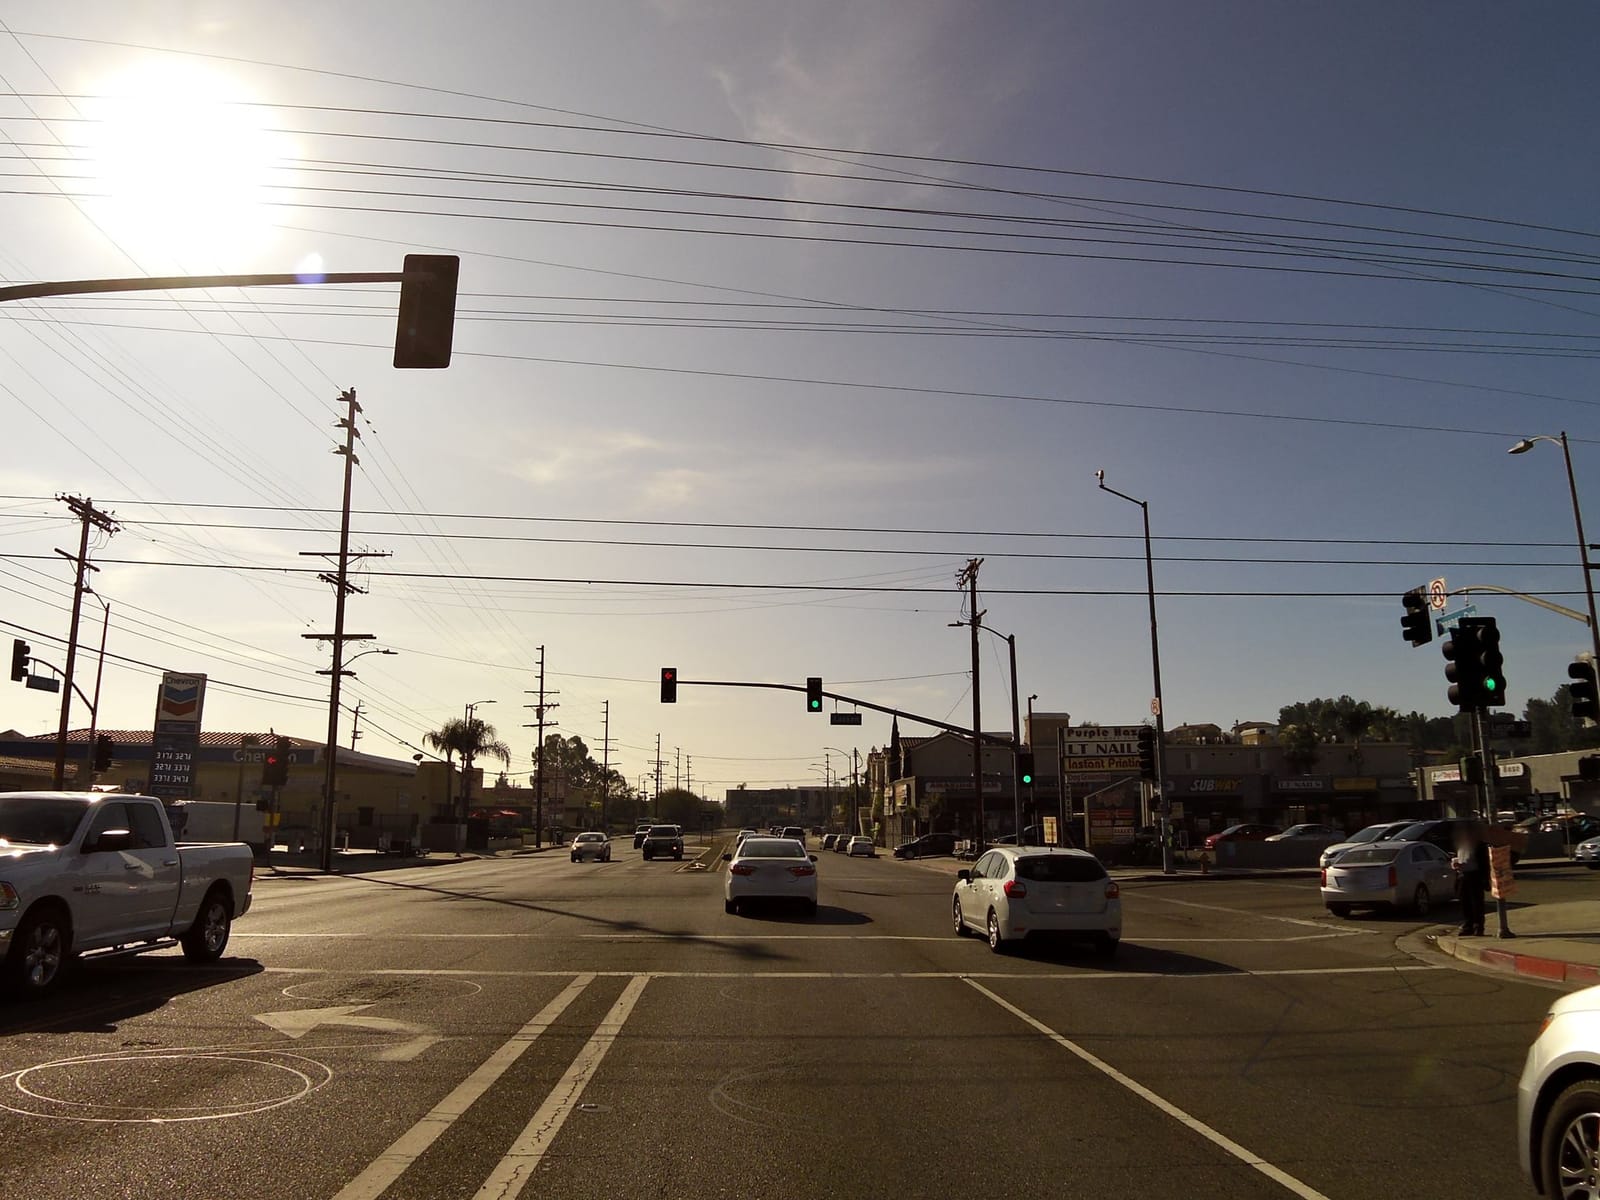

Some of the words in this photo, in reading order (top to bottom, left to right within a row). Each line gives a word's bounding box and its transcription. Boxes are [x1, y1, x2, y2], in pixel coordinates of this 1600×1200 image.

[166, 677, 200, 685] Chevron
[1067, 728, 1109, 739] Purple
[1068, 743, 1088, 754] LT
[1068, 758, 1105, 769] Instant
[1108, 757, 1143, 769] Printin
[1190, 778, 1242, 792] SUBWAY
